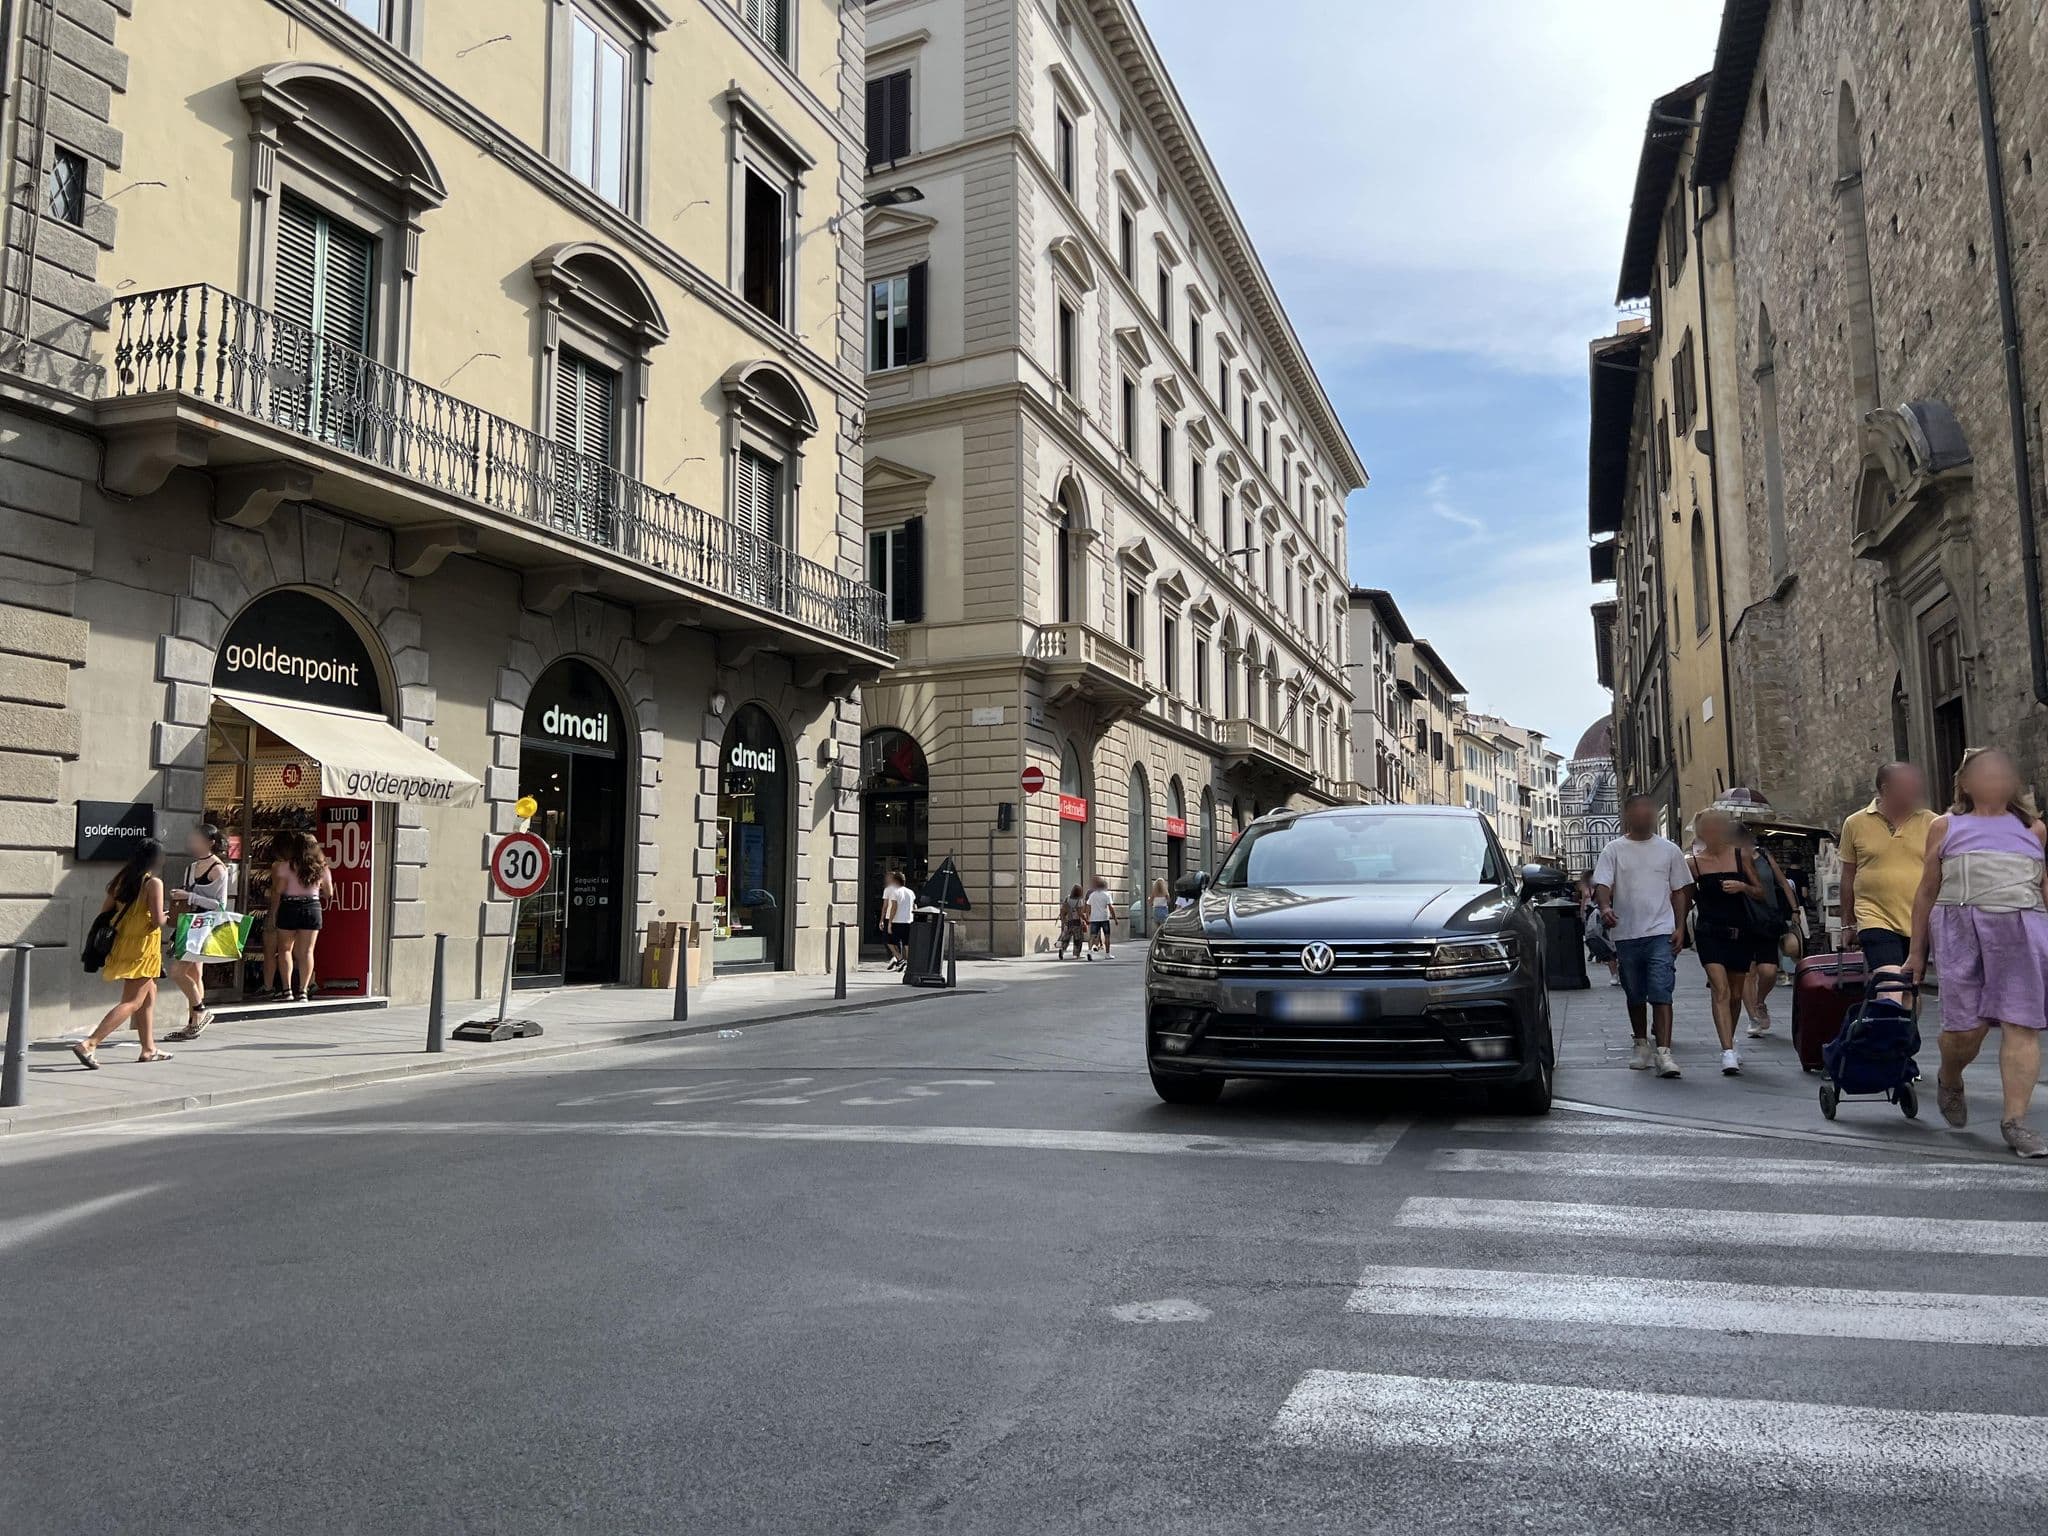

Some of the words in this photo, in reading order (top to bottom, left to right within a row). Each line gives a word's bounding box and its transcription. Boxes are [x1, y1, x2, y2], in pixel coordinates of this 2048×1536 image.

[225, 643, 359, 687] goldenpoint
[542, 704, 608, 743] dmail
[731, 742, 776, 773] dmail
[346, 771, 454, 801] goldenpoint
[329, 807, 359, 821] TUTTO
[84, 823, 148, 839] goldenpoint
[504, 849, 537, 880] 30
